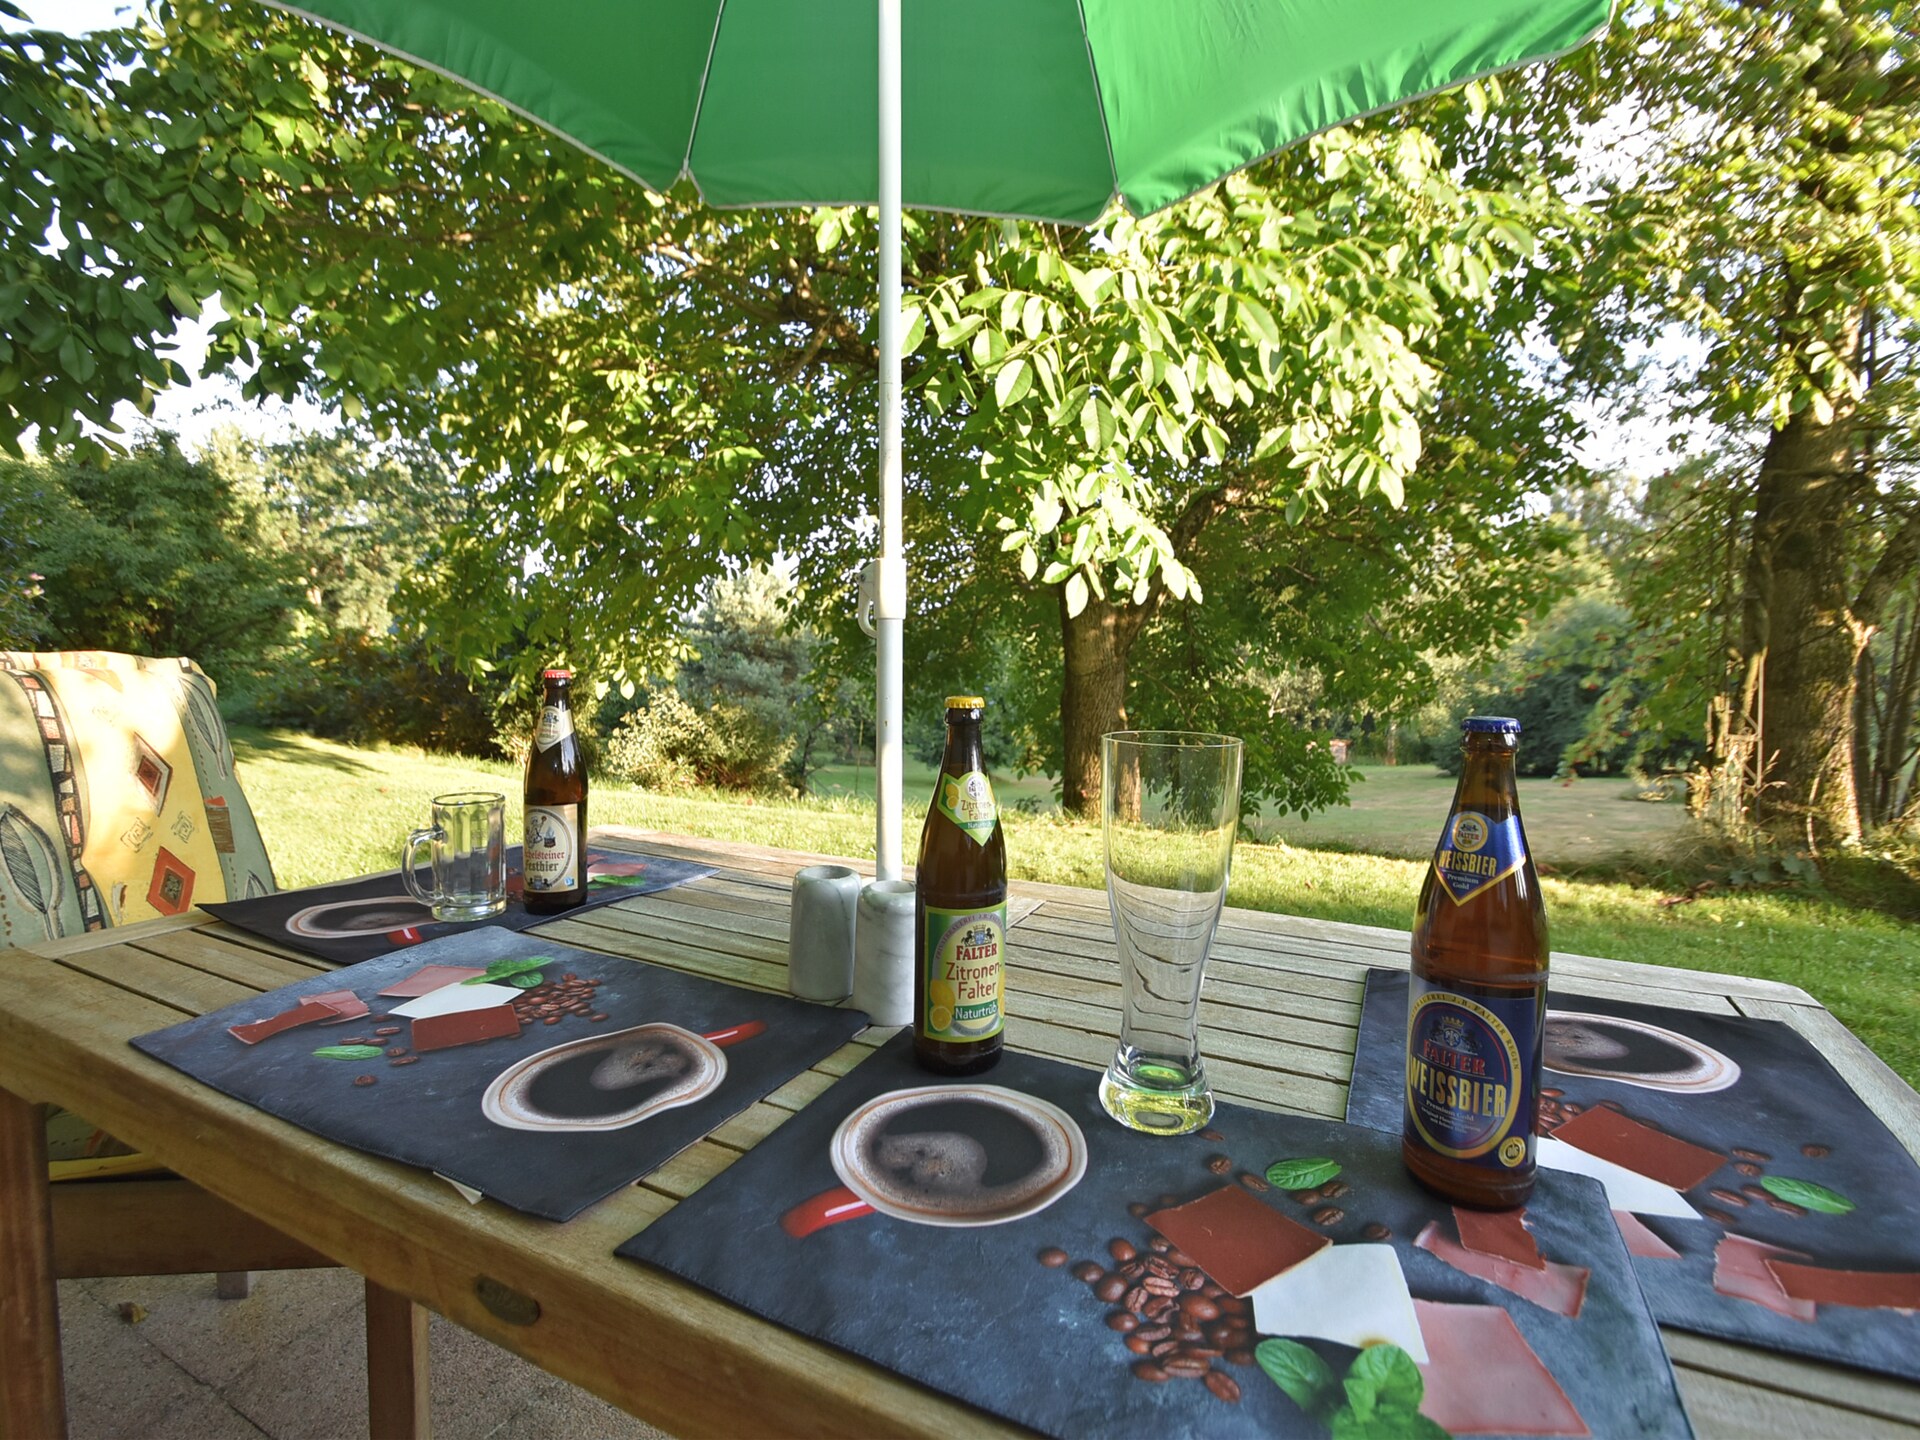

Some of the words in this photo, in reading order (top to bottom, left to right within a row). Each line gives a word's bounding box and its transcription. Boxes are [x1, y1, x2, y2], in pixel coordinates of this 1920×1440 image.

[1439, 850, 1497, 877] WEISSBIER
[1447, 873, 1479, 885] Premium
[1452, 881, 1470, 890] Gold
[956, 943, 998, 961] FALTER
[945, 961, 1003, 981] Zitronen-
[957, 981, 997, 1000] Falter
[954, 1003, 998, 1020] Naturtrüb
[1423, 1039, 1486, 1076] FALTER
[1506, 1038, 1520, 1070] REGEN
[1410, 1053, 1507, 1118] WEISSBIER
[1426, 1099, 1456, 1117] Premium
